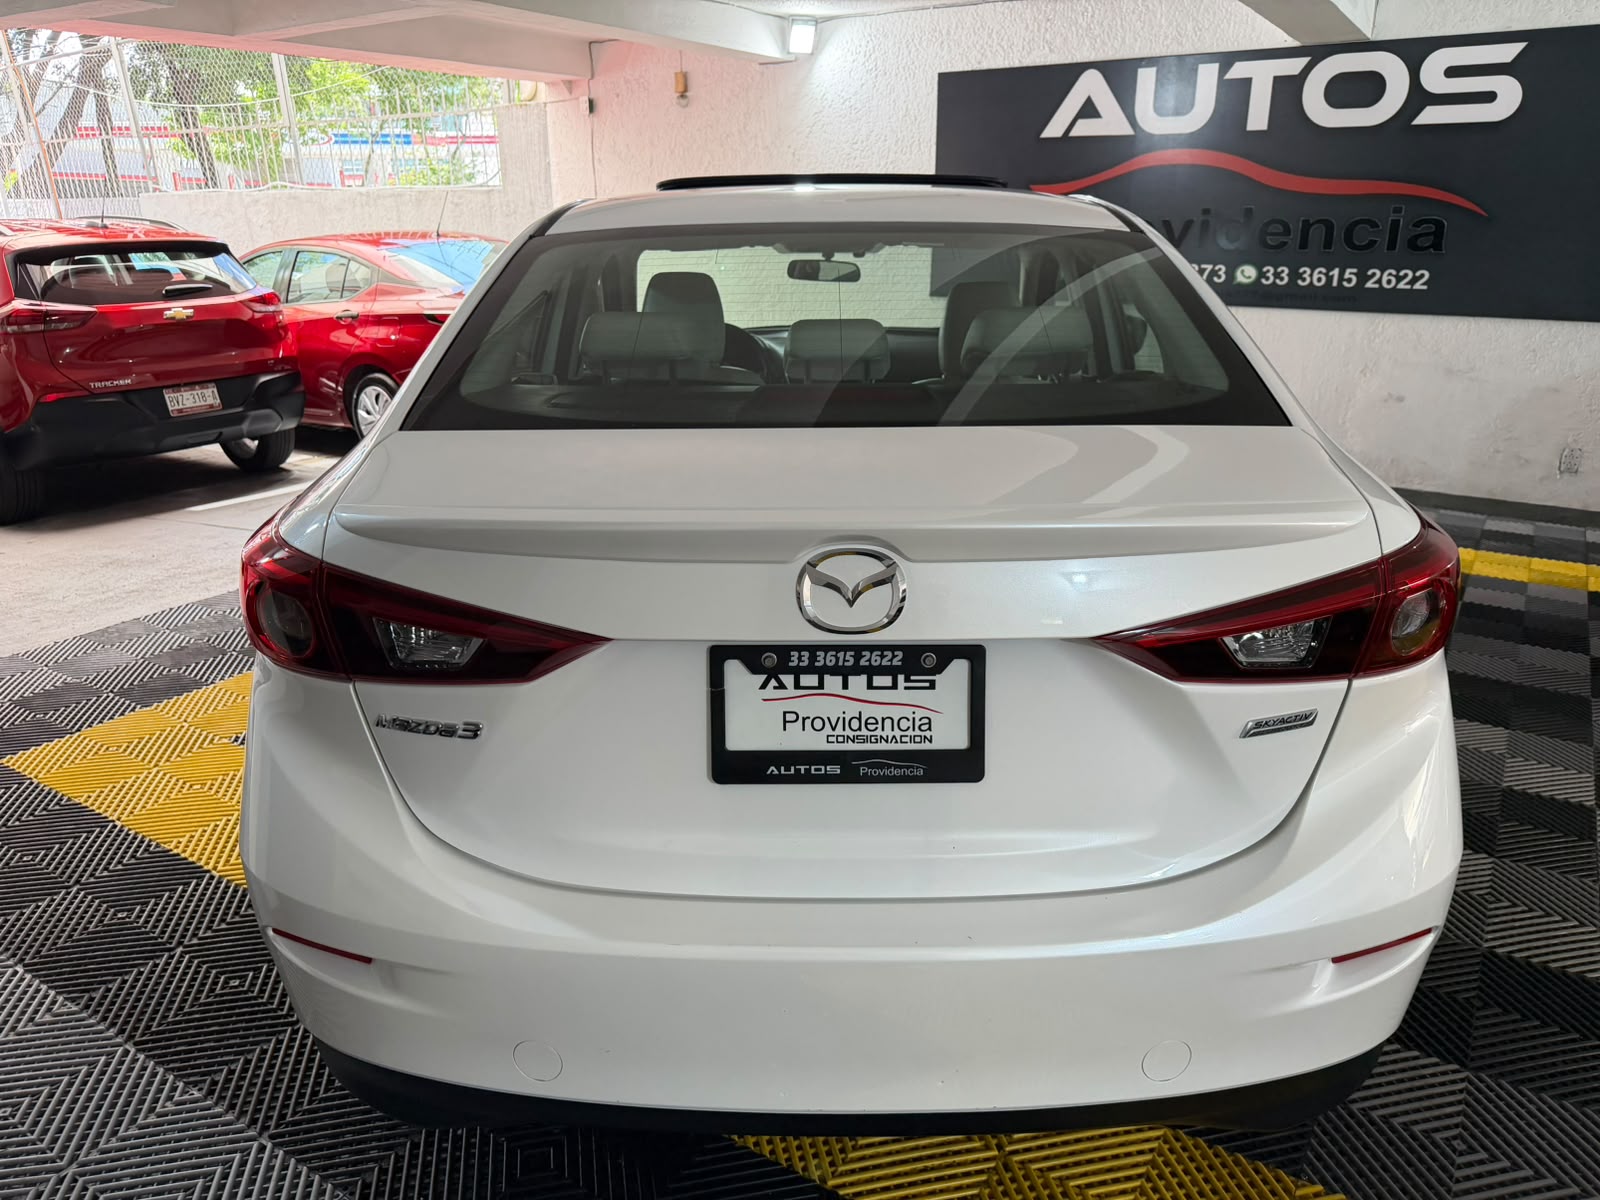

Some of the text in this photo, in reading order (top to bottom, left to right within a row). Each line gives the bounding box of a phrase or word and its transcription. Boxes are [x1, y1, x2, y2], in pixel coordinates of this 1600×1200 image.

[1039, 41, 1529, 138] AUTOS
[1145, 205, 1447, 252] videncia
[1261, 265, 1289, 285] 33
[1297, 266, 1357, 288] 3615
[1364, 268, 1430, 290] 2622
[89, 379, 132, 388] TRACKER
[788, 651, 903, 666] 33 3615 2622
[783, 710, 932, 732] Providencia
[1254, 711, 1313, 729] SKYACTIV
[826, 734, 932, 744] CONSIGNACION
[766, 765, 924, 776] AUTOS Providencia
